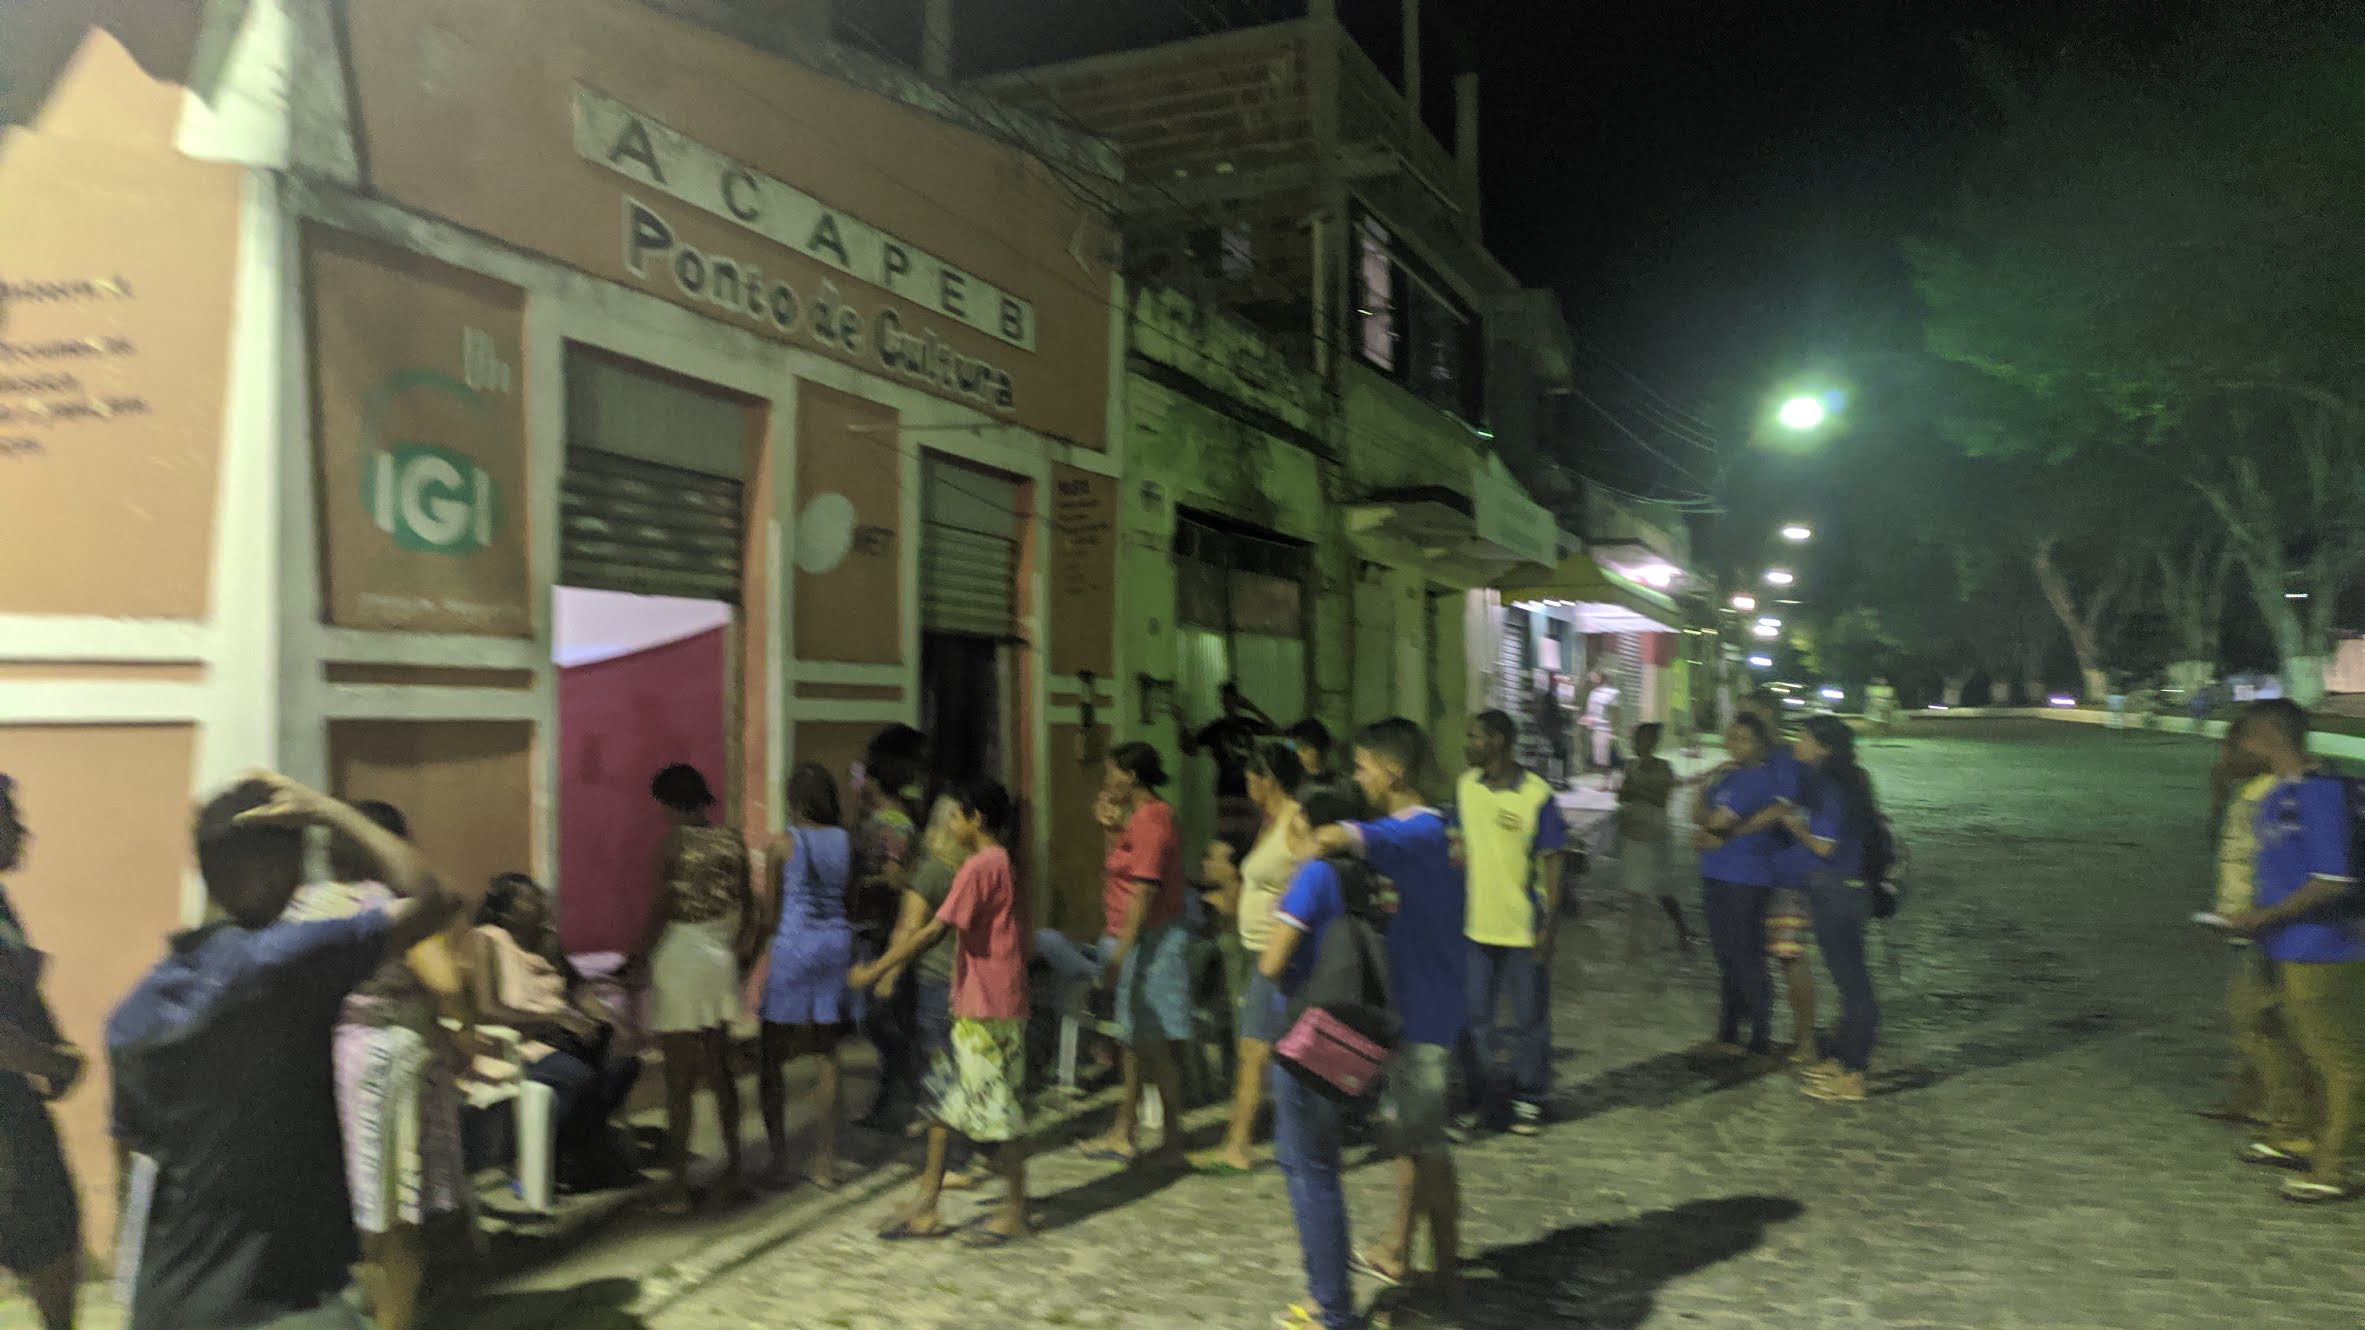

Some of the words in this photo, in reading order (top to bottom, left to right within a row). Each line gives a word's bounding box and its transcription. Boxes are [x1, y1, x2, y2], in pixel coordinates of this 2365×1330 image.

[623, 196, 799, 333] Ponto
[807, 277, 864, 355] de
[873, 307, 1016, 413] Cultura
